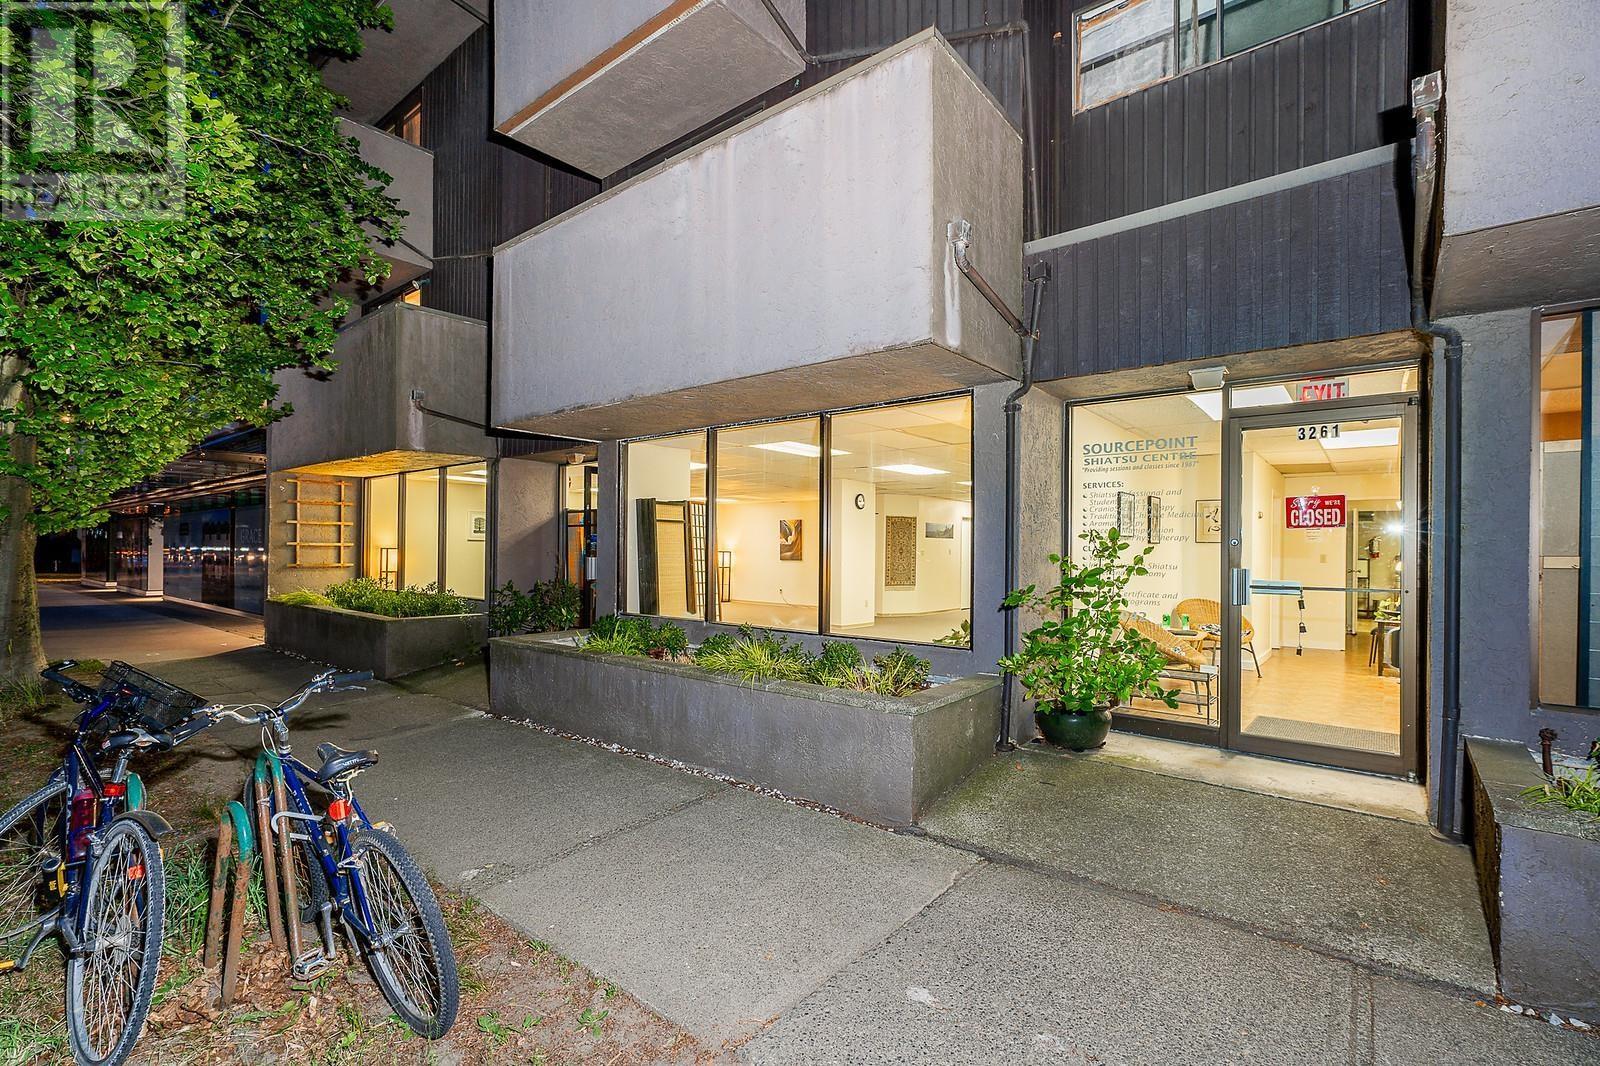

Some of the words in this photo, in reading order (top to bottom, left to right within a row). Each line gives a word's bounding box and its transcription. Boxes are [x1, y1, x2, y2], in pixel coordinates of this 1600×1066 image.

[1298, 424, 1340, 440] 3261
[1083, 436, 1198, 455] SOURCEPOINT
[1084, 455, 1138, 466] SHIATSU
[1143, 450, 1197, 463] CENTRE
[1083, 481, 1125, 489] SERVICES:
[1165, 488, 1183, 496] and
[1290, 508, 1341, 526] CLOSED
[1123, 590, 1160, 599] ertificate
[1161, 591, 1179, 600] and
[1127, 599, 1161, 607] rograms
